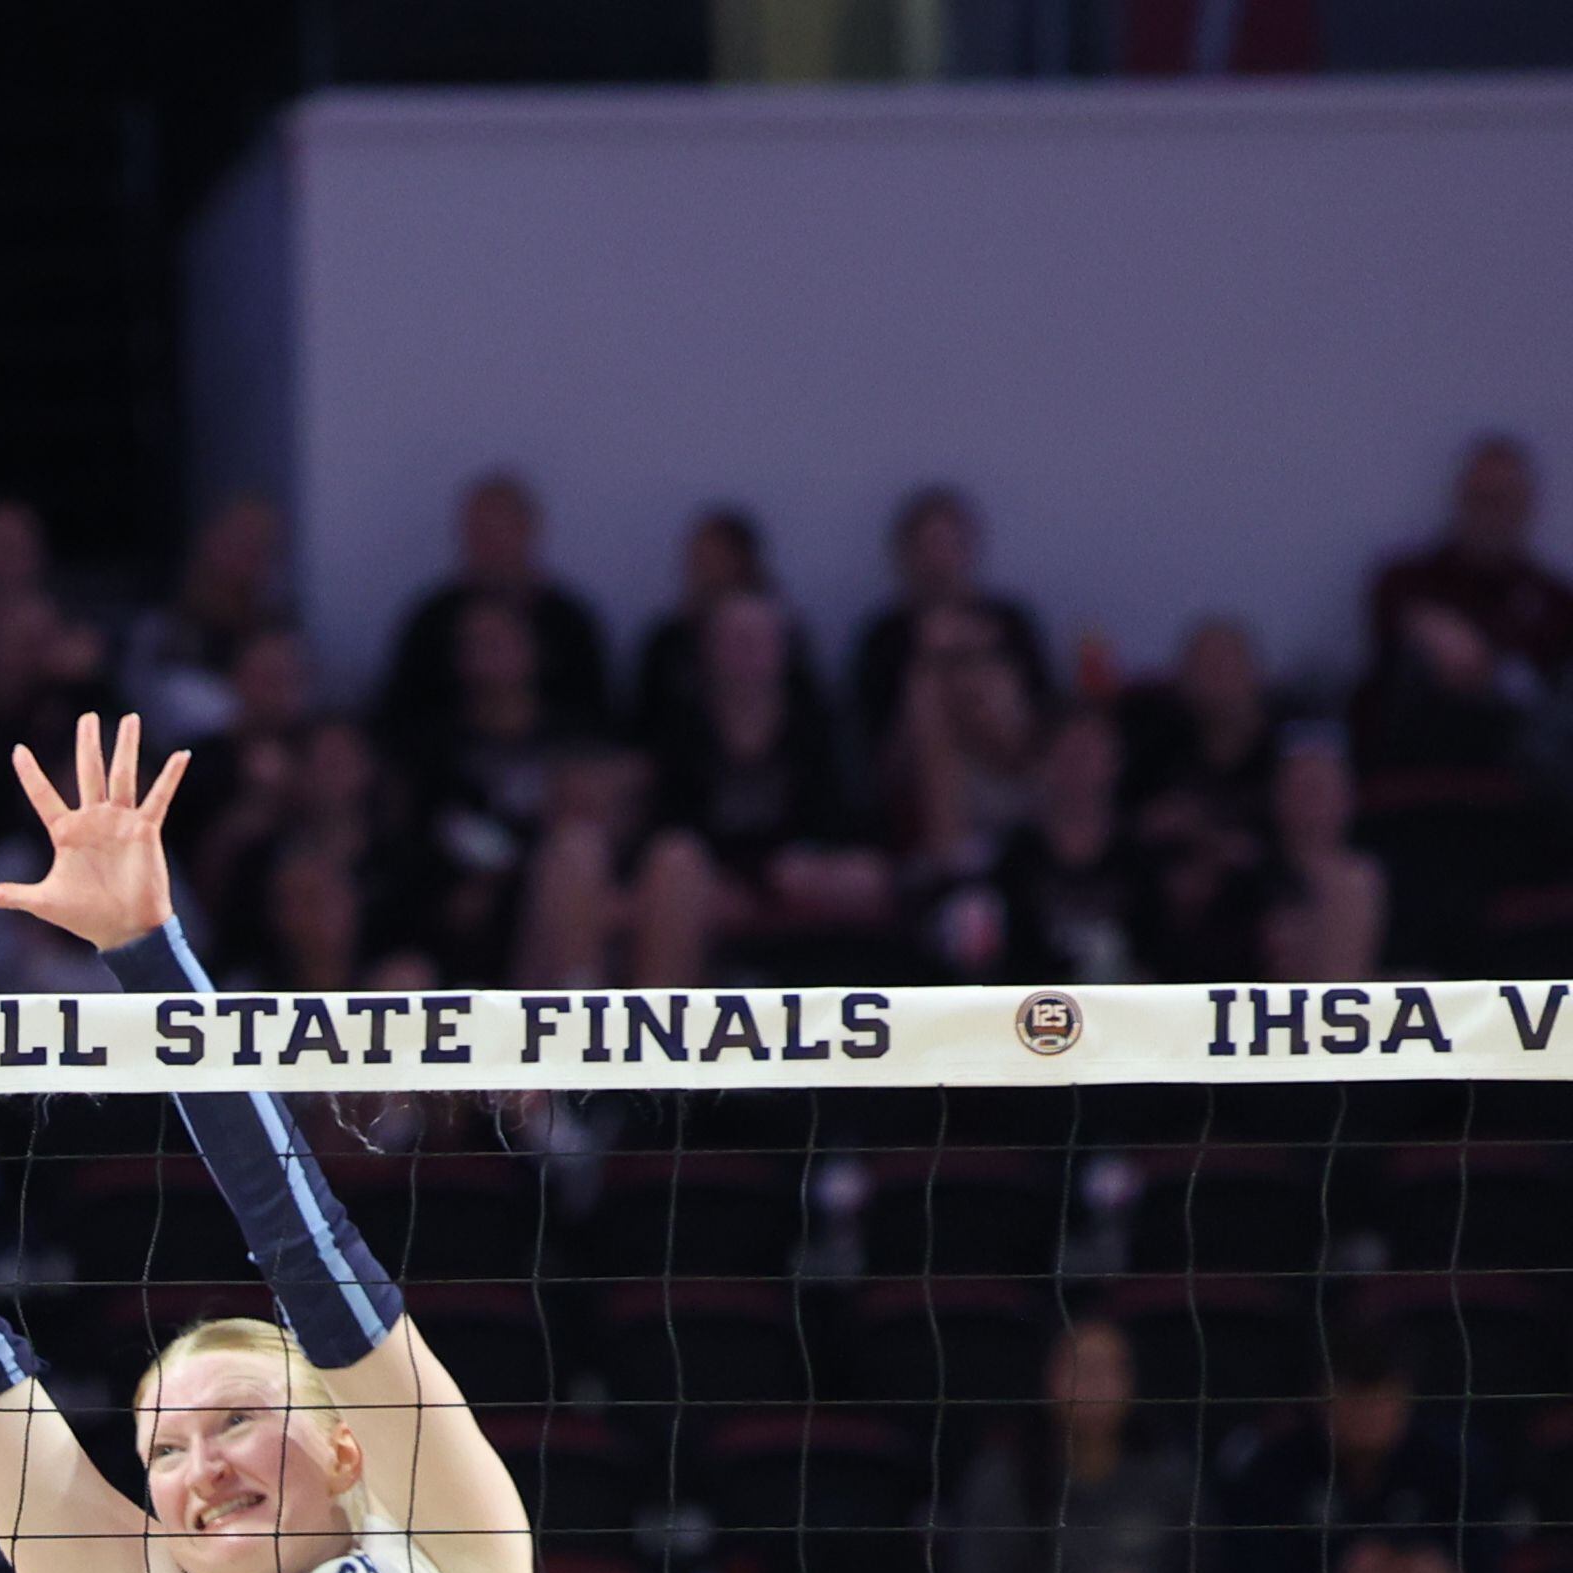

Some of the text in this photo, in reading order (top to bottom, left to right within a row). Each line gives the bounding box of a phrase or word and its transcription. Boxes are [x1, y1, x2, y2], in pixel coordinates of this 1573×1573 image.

[156, 997, 471, 1066] STATE
[522, 994, 890, 1064] FINALS
[1032, 1004, 1067, 1027] 125
[1209, 987, 1452, 1056] IHSA
